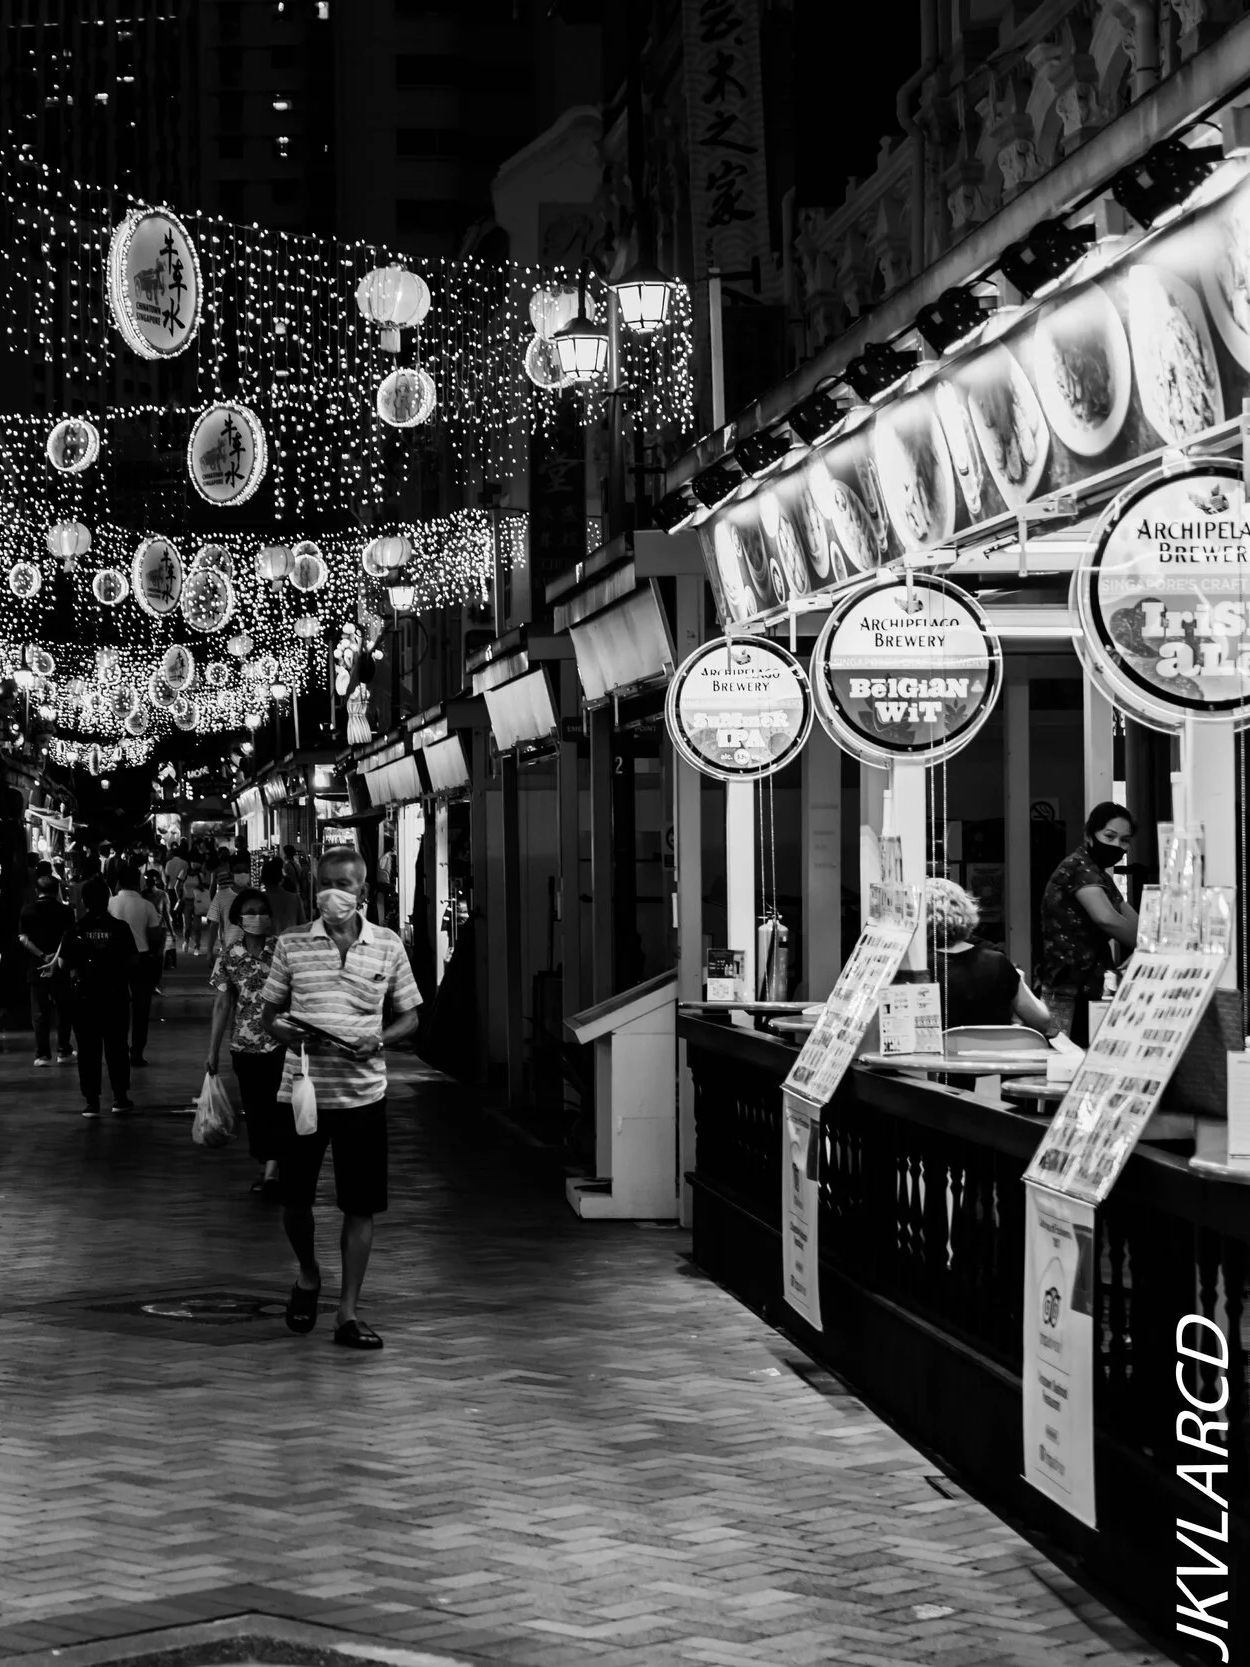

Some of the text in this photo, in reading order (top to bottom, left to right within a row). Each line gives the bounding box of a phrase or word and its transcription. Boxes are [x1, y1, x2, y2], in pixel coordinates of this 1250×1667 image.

[135, 311, 161, 326] SINGAPORE
[859, 616, 960, 631] ARCHIPELAGO
[874, 632, 946, 648] BREWERY
[712, 680, 770, 692] BREWERY
[716, 728, 766, 748] IPA
[614, 756, 624, 775] 2
